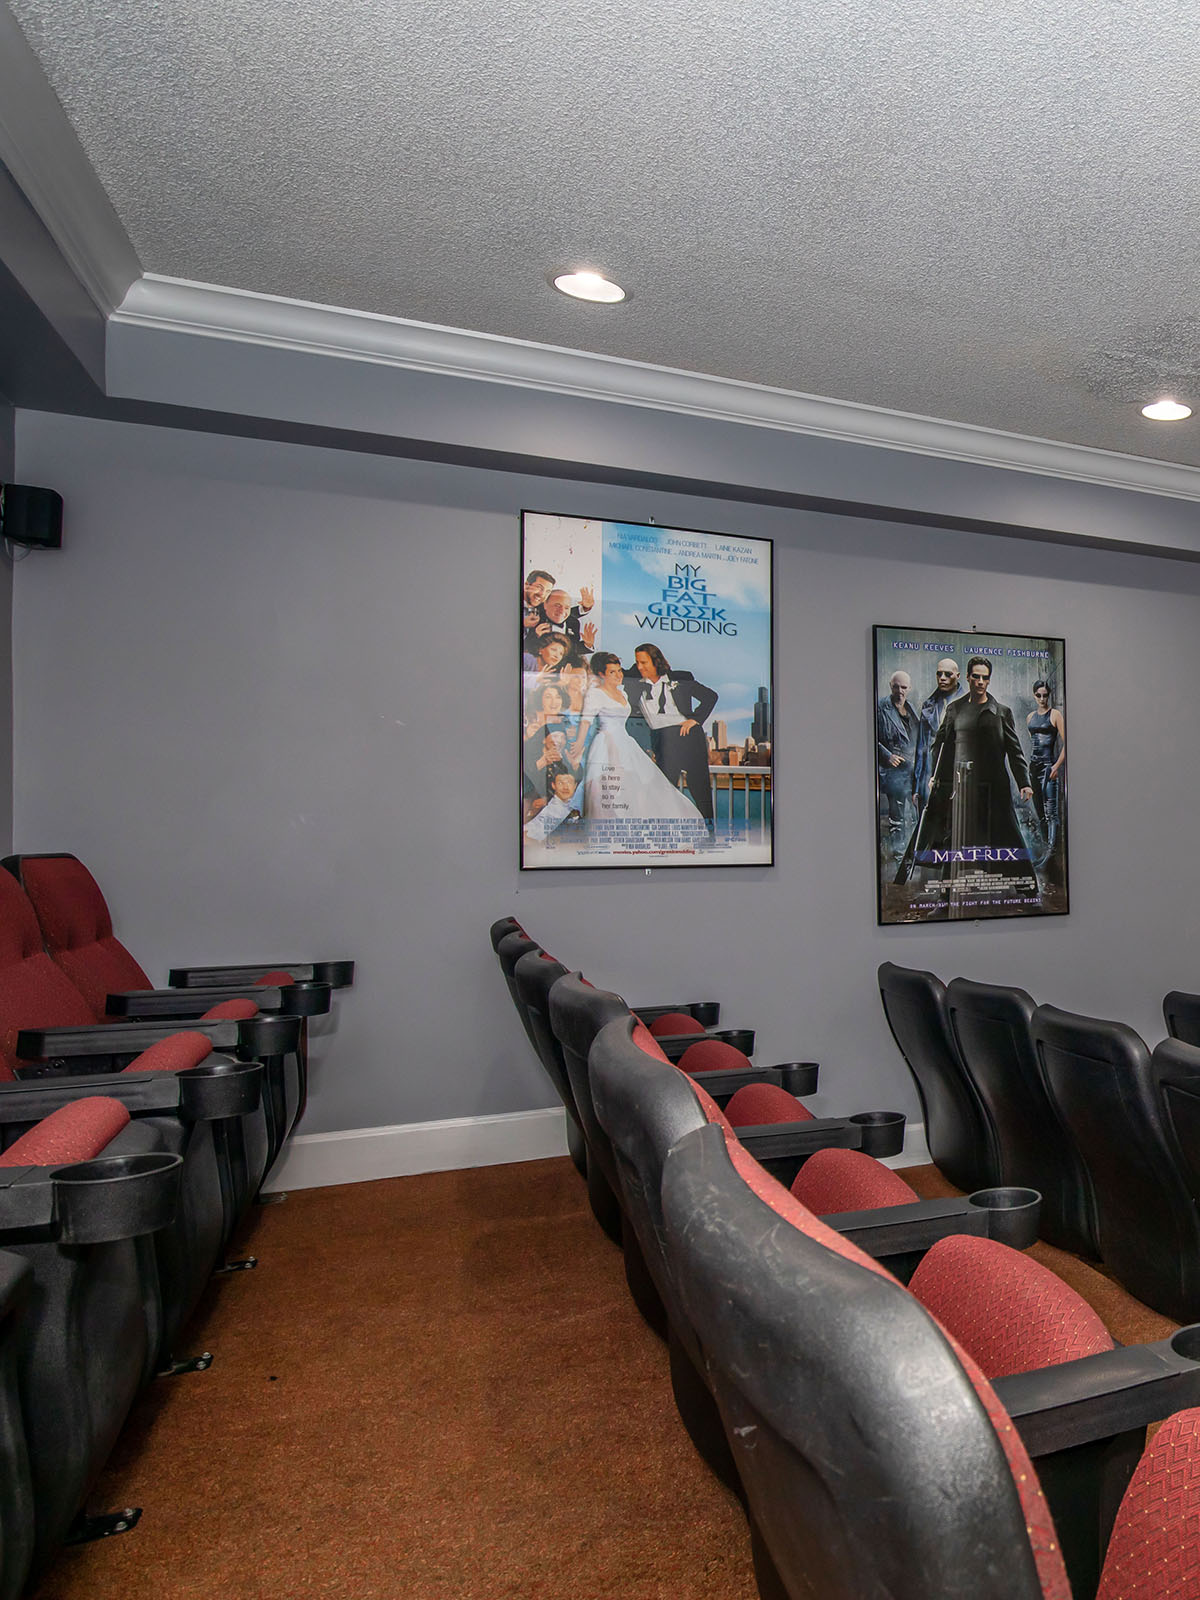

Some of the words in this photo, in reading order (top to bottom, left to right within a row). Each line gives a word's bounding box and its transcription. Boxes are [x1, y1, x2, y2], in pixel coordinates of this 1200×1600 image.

[675, 563, 701, 577] MY
[668, 575, 707, 592] BIG
[662, 589, 717, 606] FAT
[635, 614, 738, 637] WEDDING
[893, 642, 919, 650] KEANU
[924, 643, 954, 652] REEVES
[964, 647, 1002, 656] LAURENCE
[1007, 650, 1049, 659] FISHBURNE
[931, 848, 1019, 864] MATRIX
